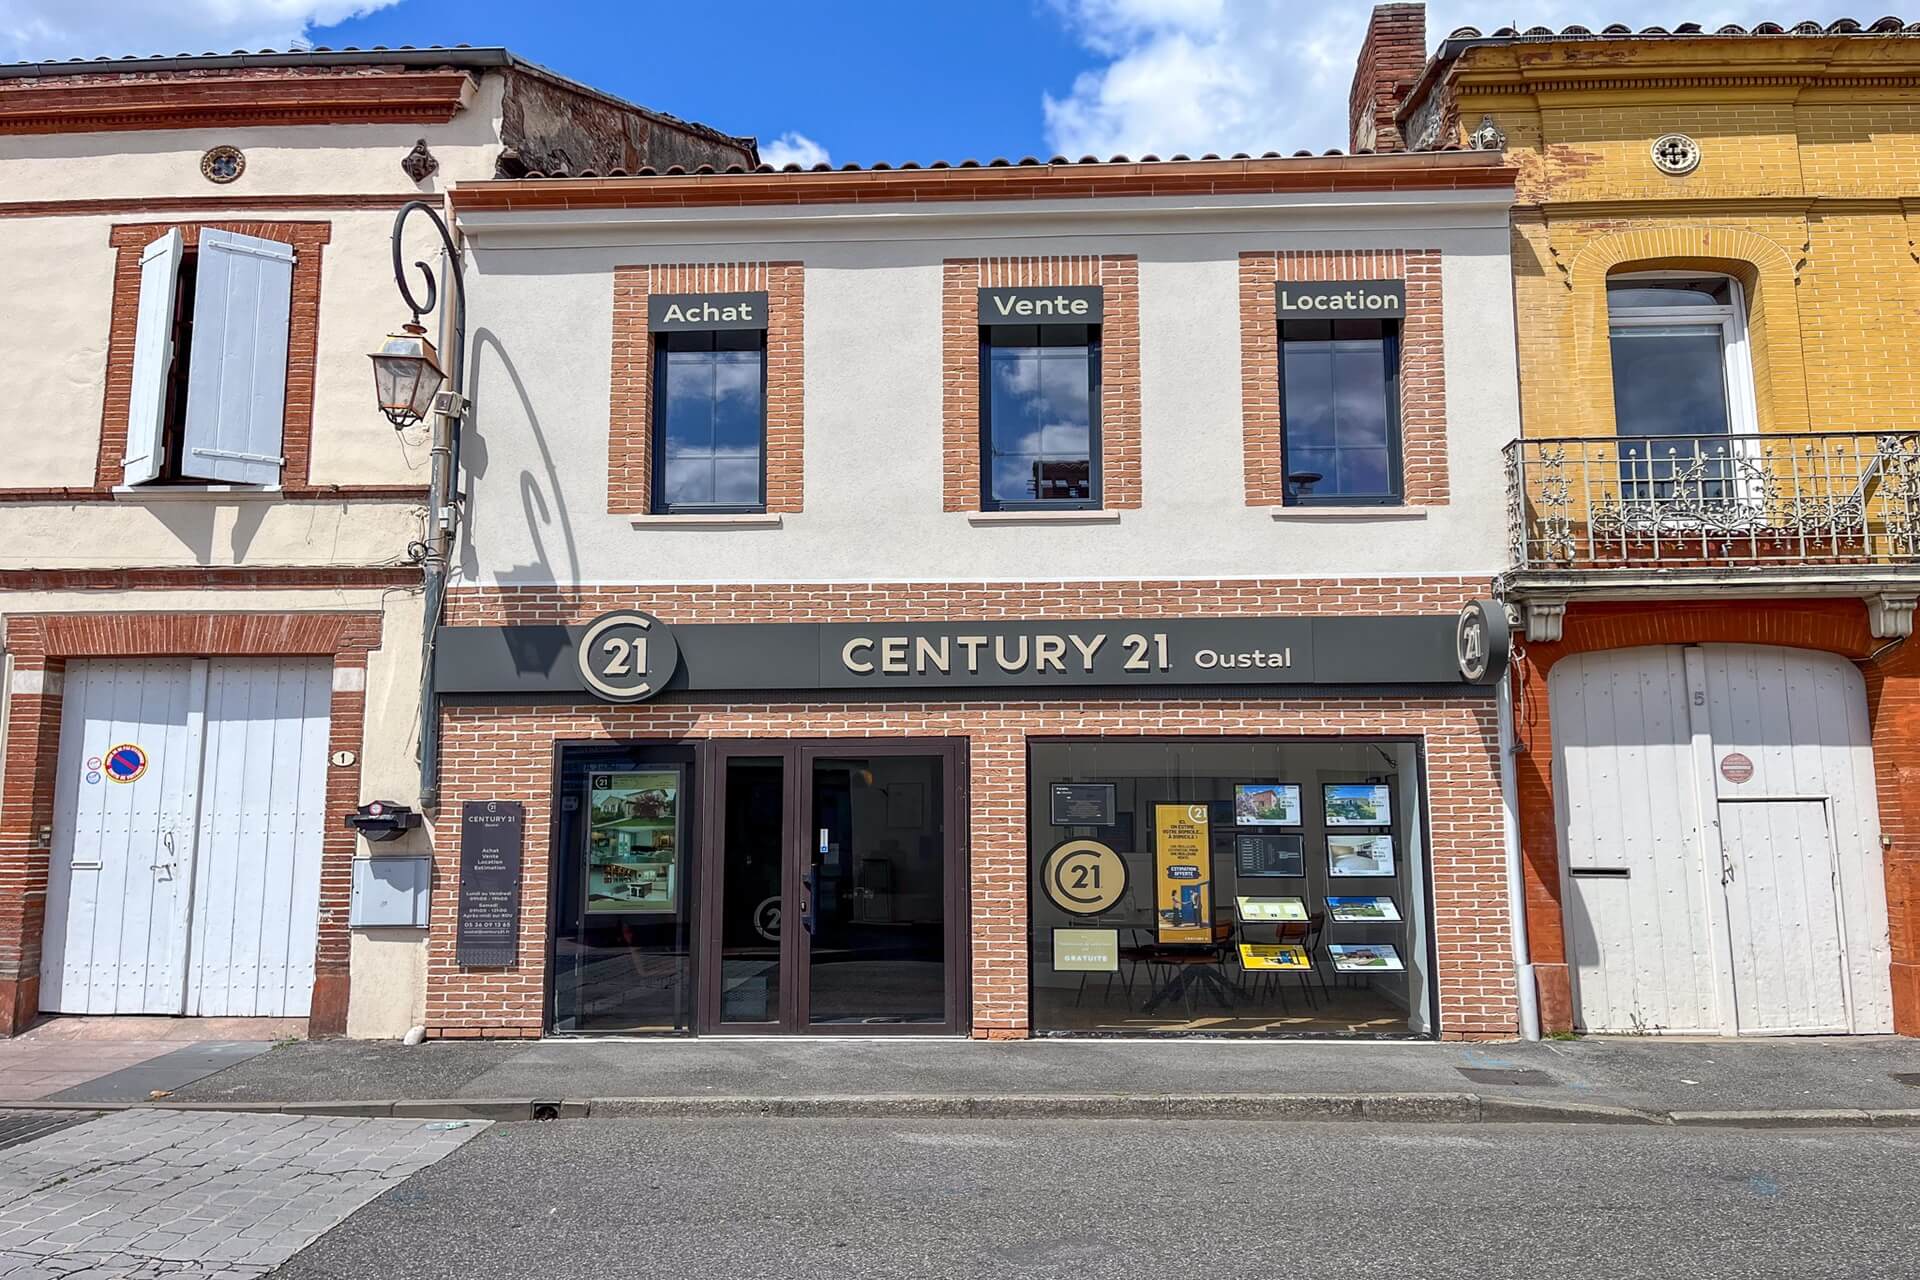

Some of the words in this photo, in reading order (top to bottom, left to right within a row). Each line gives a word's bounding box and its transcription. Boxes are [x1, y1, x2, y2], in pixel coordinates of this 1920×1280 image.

[993, 295, 1089, 316] Vente
[1281, 289, 1399, 310] Location
[663, 302, 753, 323] Achat
[841, 633, 1108, 673] CENTURY
[1122, 633, 1170, 670] 21
[1193, 647, 1292, 669] Oustal
[1694, 691, 1705, 706] 5
[341, 753, 345, 764] 1
[468, 815, 507, 823] CENTURY
[1064, 954, 1108, 962] GRATUITE
